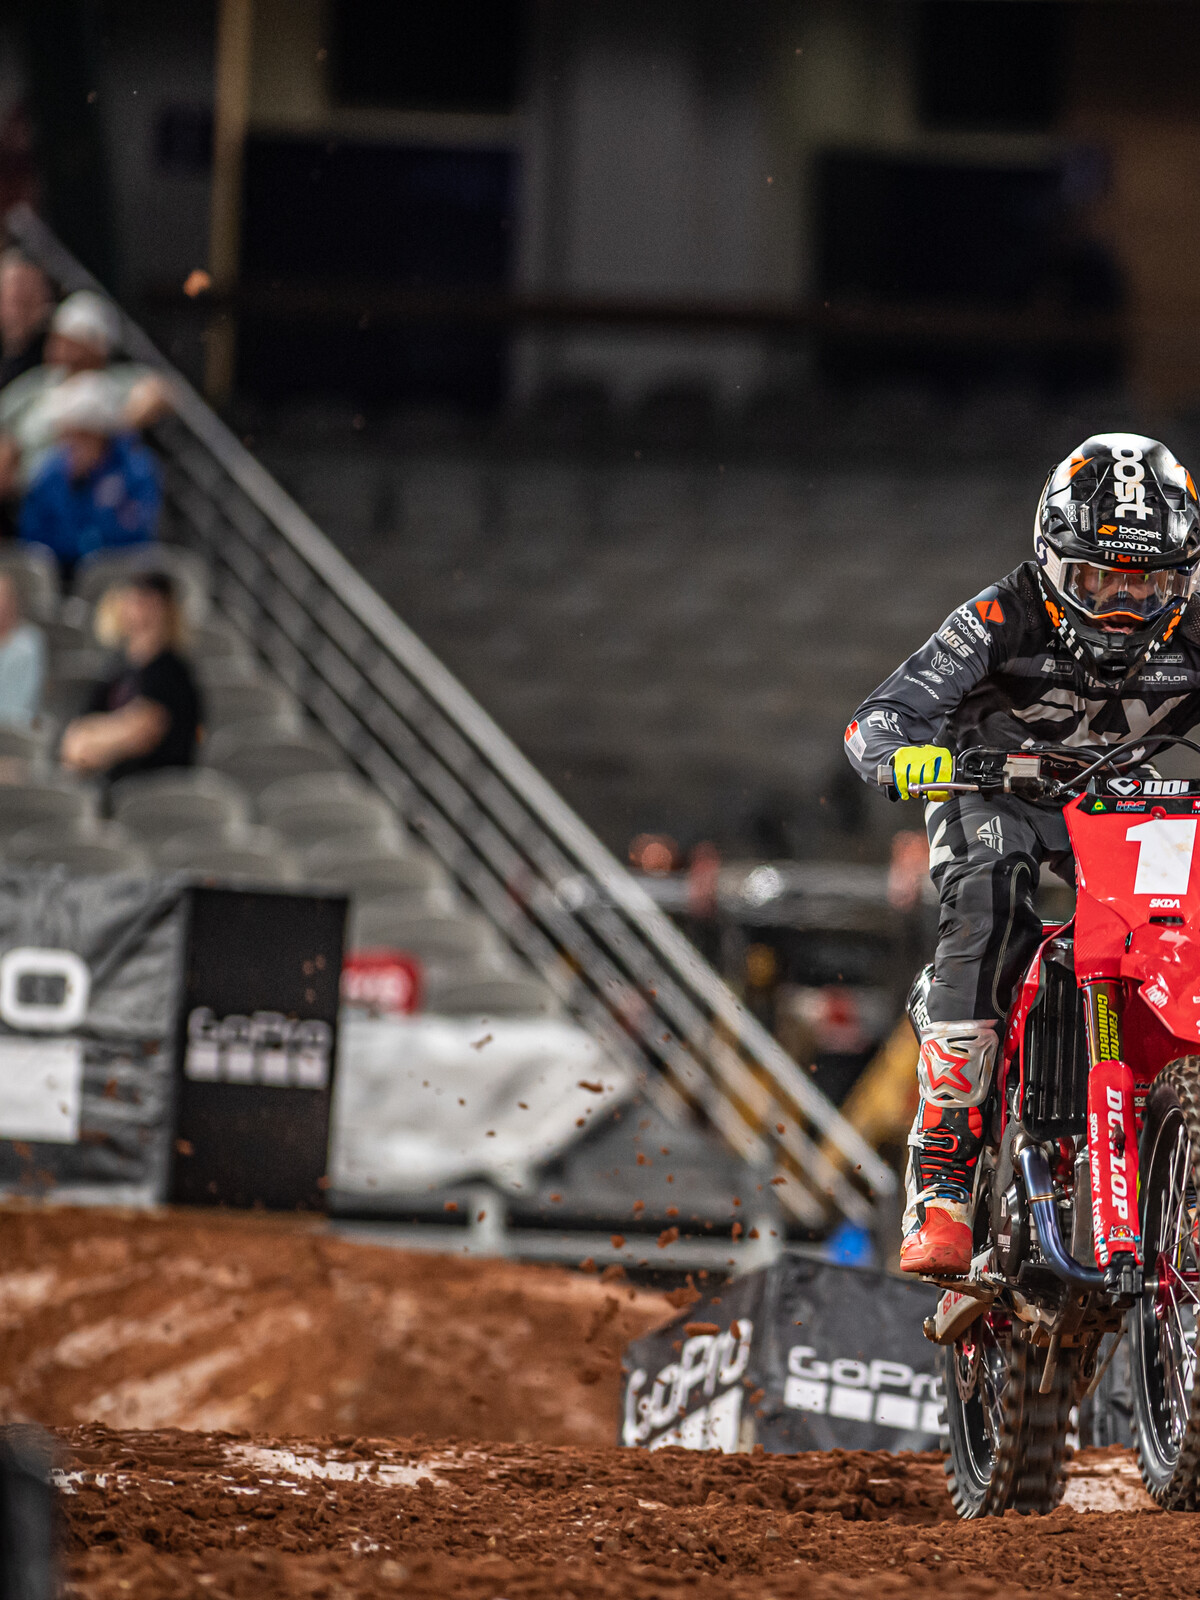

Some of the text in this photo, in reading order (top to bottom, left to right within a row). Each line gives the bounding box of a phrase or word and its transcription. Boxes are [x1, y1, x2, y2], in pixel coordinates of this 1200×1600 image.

[1111, 447, 1154, 520] oost
[1097, 540, 1162, 553] HONDA
[1118, 525, 1162, 540] boost
[1118, 534, 1148, 542] mobile
[952, 616, 977, 644] mobile
[956, 603, 993, 647] boost
[940, 626, 975, 658] HGS
[909, 677, 940, 700] DUNLOP
[1125, 819, 1198, 895] 1
[1149, 899, 1181, 909] SKDA
[1097, 993, 1111, 1062] Connect
[1109, 1009, 1119, 1061] Factor
[1106, 1086, 1129, 1220] DULOP
